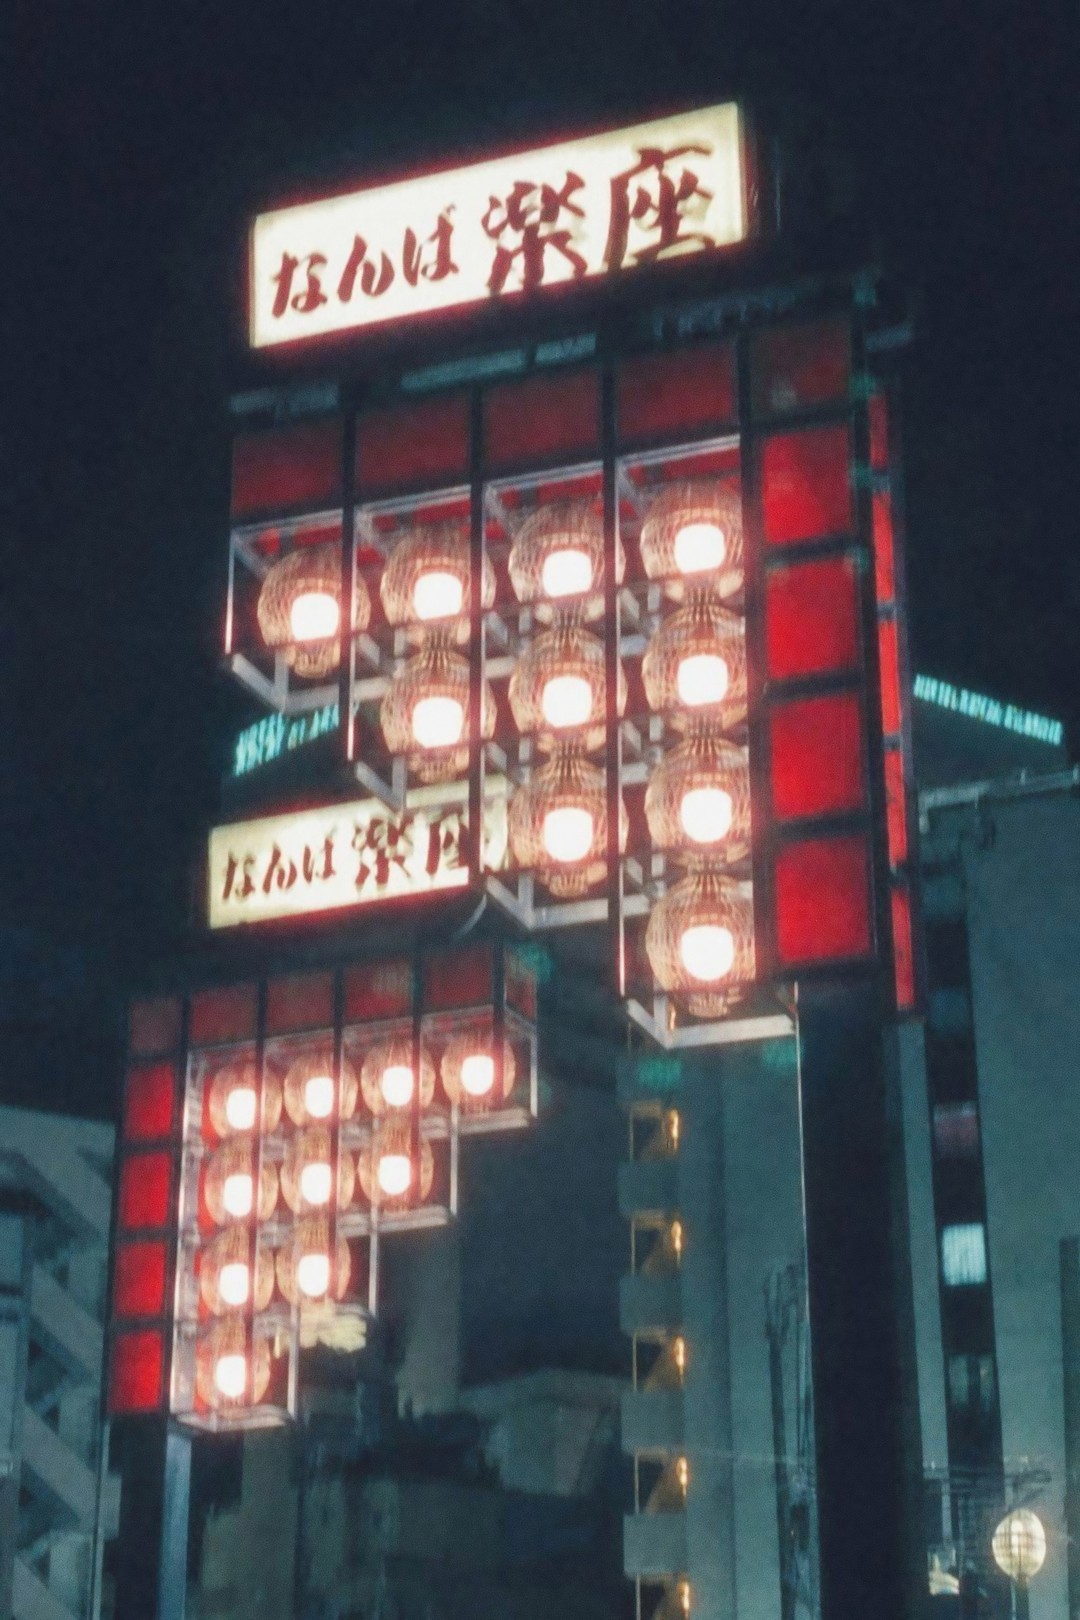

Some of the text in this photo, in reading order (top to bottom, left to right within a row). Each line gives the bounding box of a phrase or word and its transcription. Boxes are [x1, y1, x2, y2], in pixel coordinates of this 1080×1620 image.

[271, 143, 716, 319] なんば楽座
